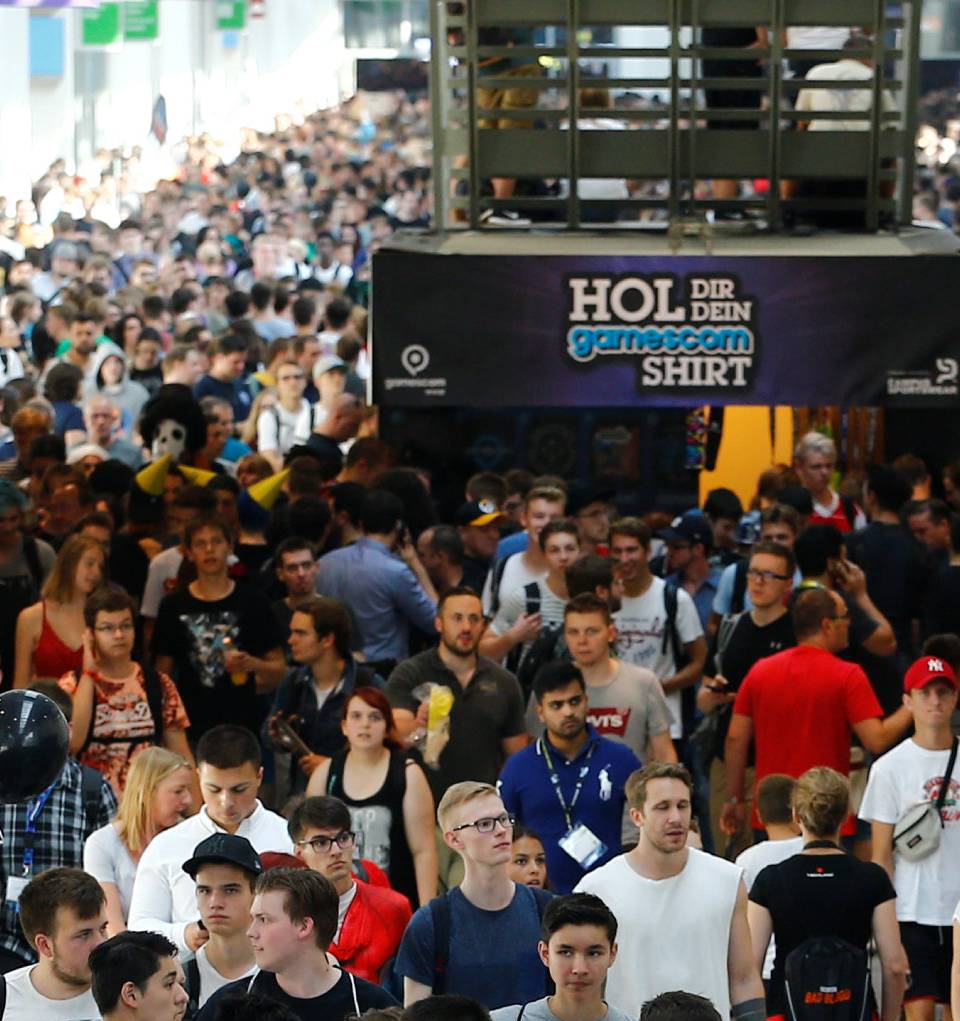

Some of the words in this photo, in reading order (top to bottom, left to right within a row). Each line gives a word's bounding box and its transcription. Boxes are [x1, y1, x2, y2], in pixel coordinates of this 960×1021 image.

[569, 277, 686, 323] HOL
[691, 278, 735, 299] DIR
[691, 301, 753, 322] DEIN
[568, 325, 754, 362] gamescom
[642, 356, 752, 386] SHIRT
